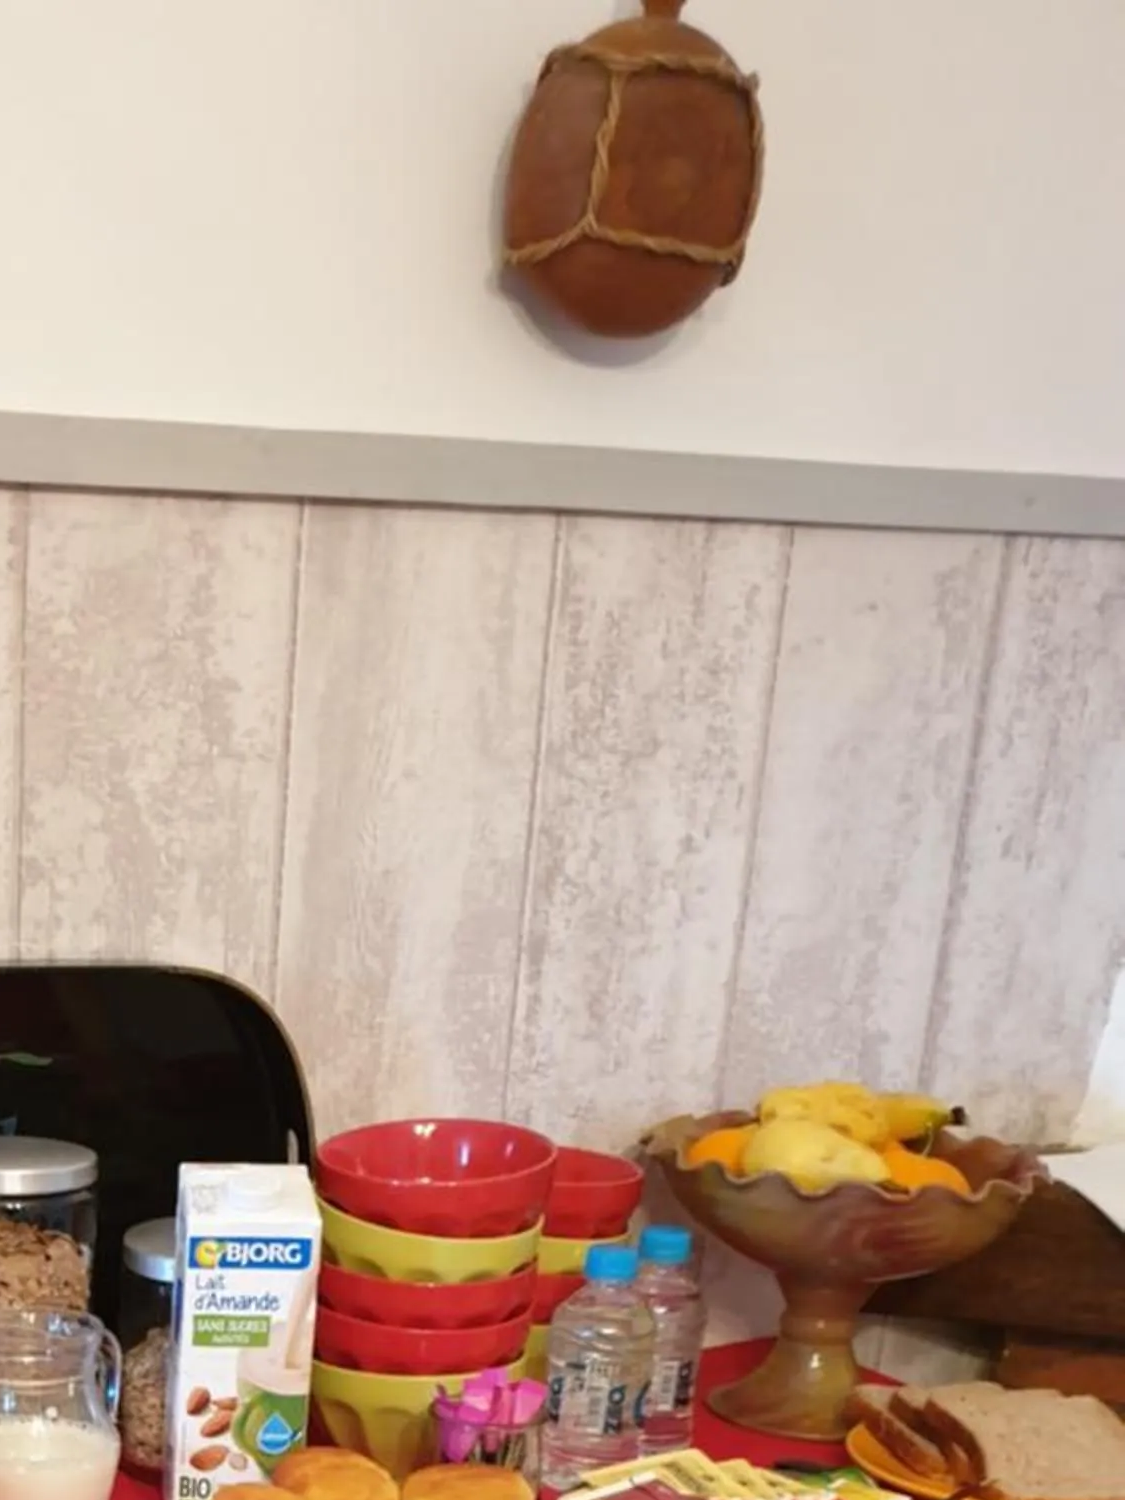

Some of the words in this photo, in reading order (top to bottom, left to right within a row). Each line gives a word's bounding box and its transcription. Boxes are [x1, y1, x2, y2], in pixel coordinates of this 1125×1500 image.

[227, 1243, 303, 1265] BJORG
[195, 1274, 226, 1291] Lait
[194, 1292, 281, 1312] d'Amande
[179, 1476, 211, 1499] BIO
